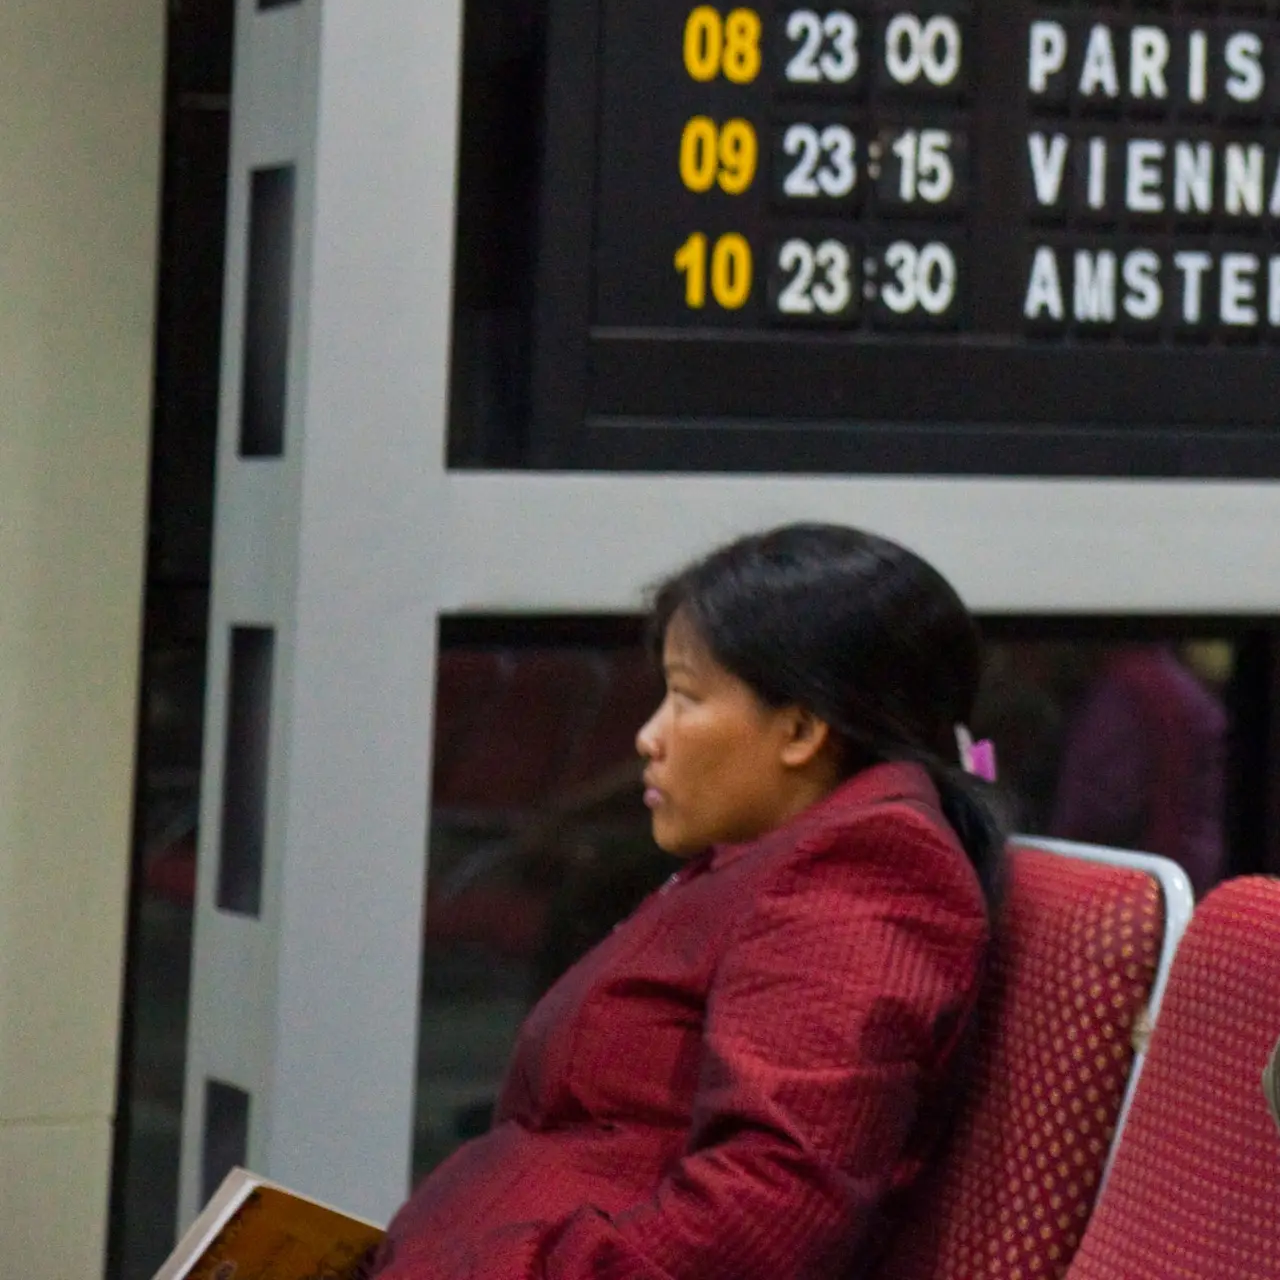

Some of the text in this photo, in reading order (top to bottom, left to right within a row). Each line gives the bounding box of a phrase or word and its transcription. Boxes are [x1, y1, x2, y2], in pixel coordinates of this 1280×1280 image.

[685, 8, 760, 81] 08
[786, 11, 857, 81] 23
[886, 15, 959, 84] 00
[1029, 22, 1262, 101] PARIS
[681, 119, 756, 192] 09
[676, 235, 750, 307] 10
